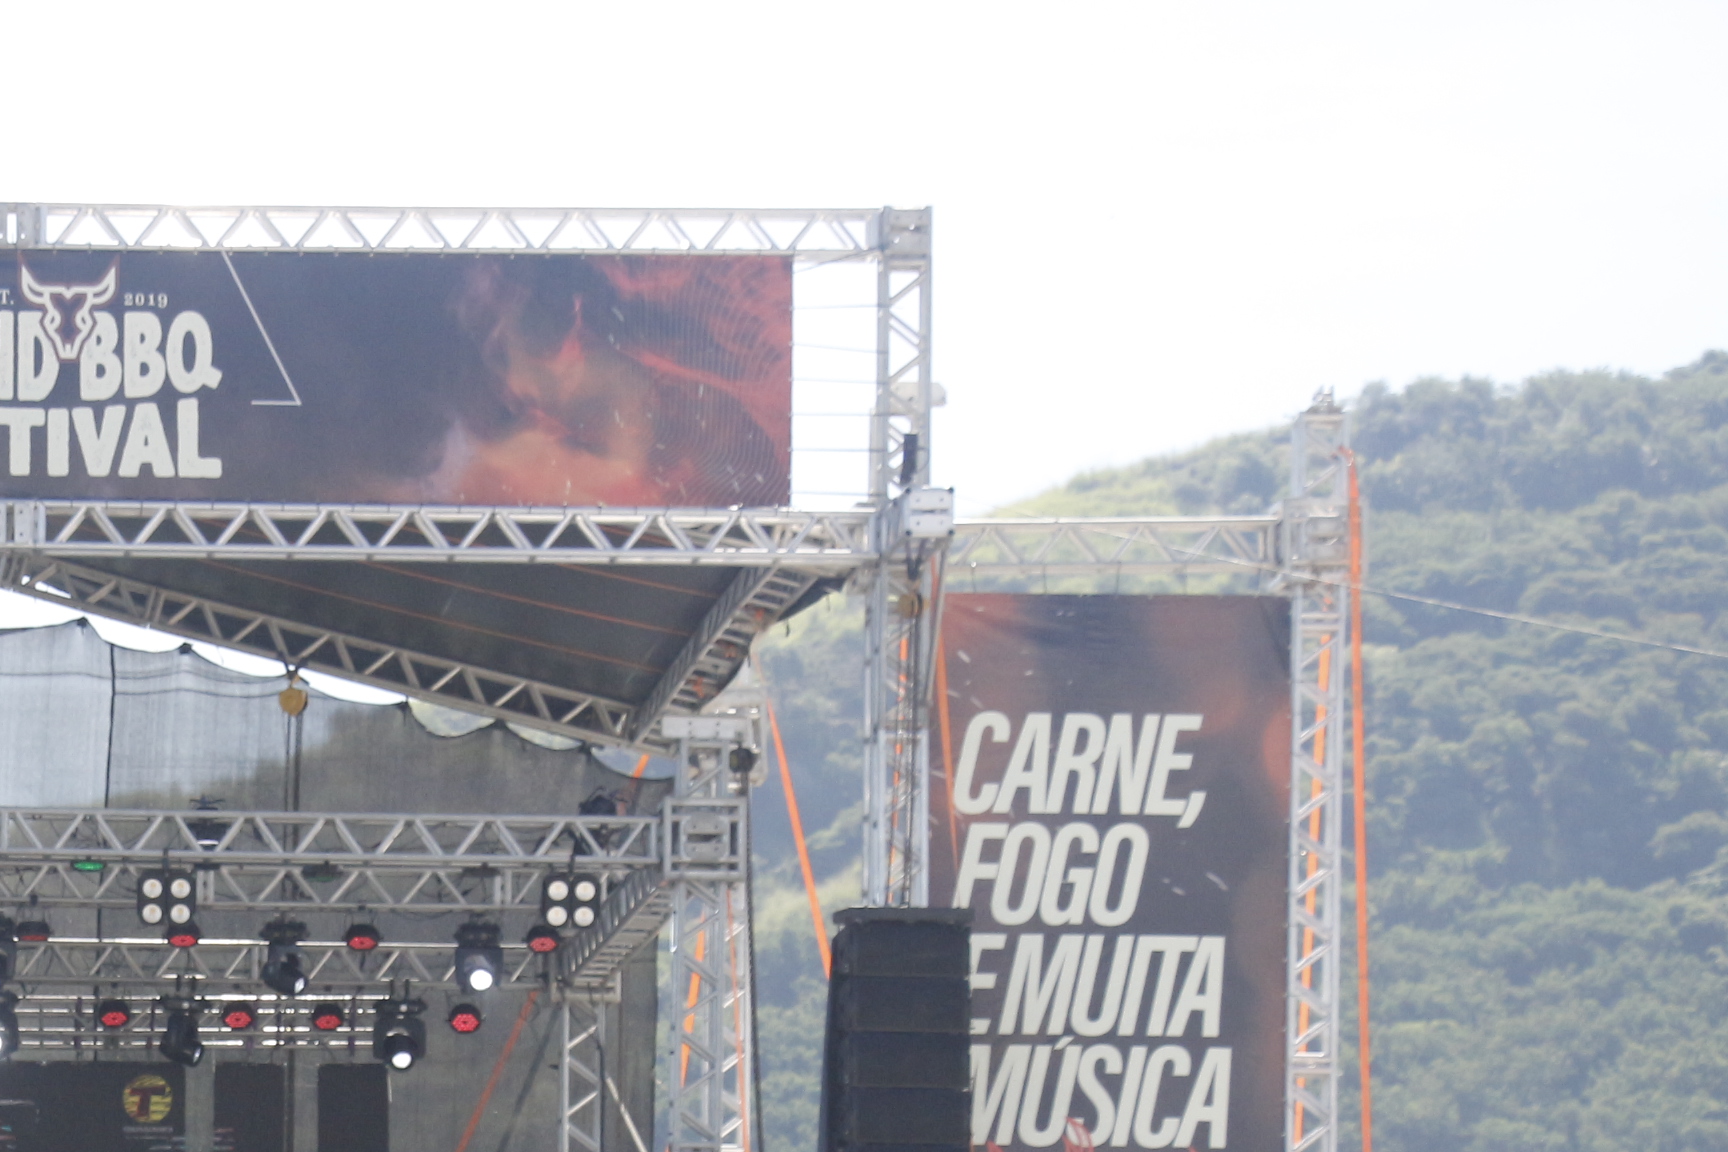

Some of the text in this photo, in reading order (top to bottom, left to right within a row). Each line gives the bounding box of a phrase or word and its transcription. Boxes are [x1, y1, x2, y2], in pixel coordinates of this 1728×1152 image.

[124, 293, 168, 308] 2019
[80, 310, 223, 401] BBQ
[953, 711, 1206, 829] CARNE,
[953, 822, 1149, 927] FOGO
[998, 933, 1226, 1038] MUITA
[969, 1036, 1232, 1149] MÚSICA
